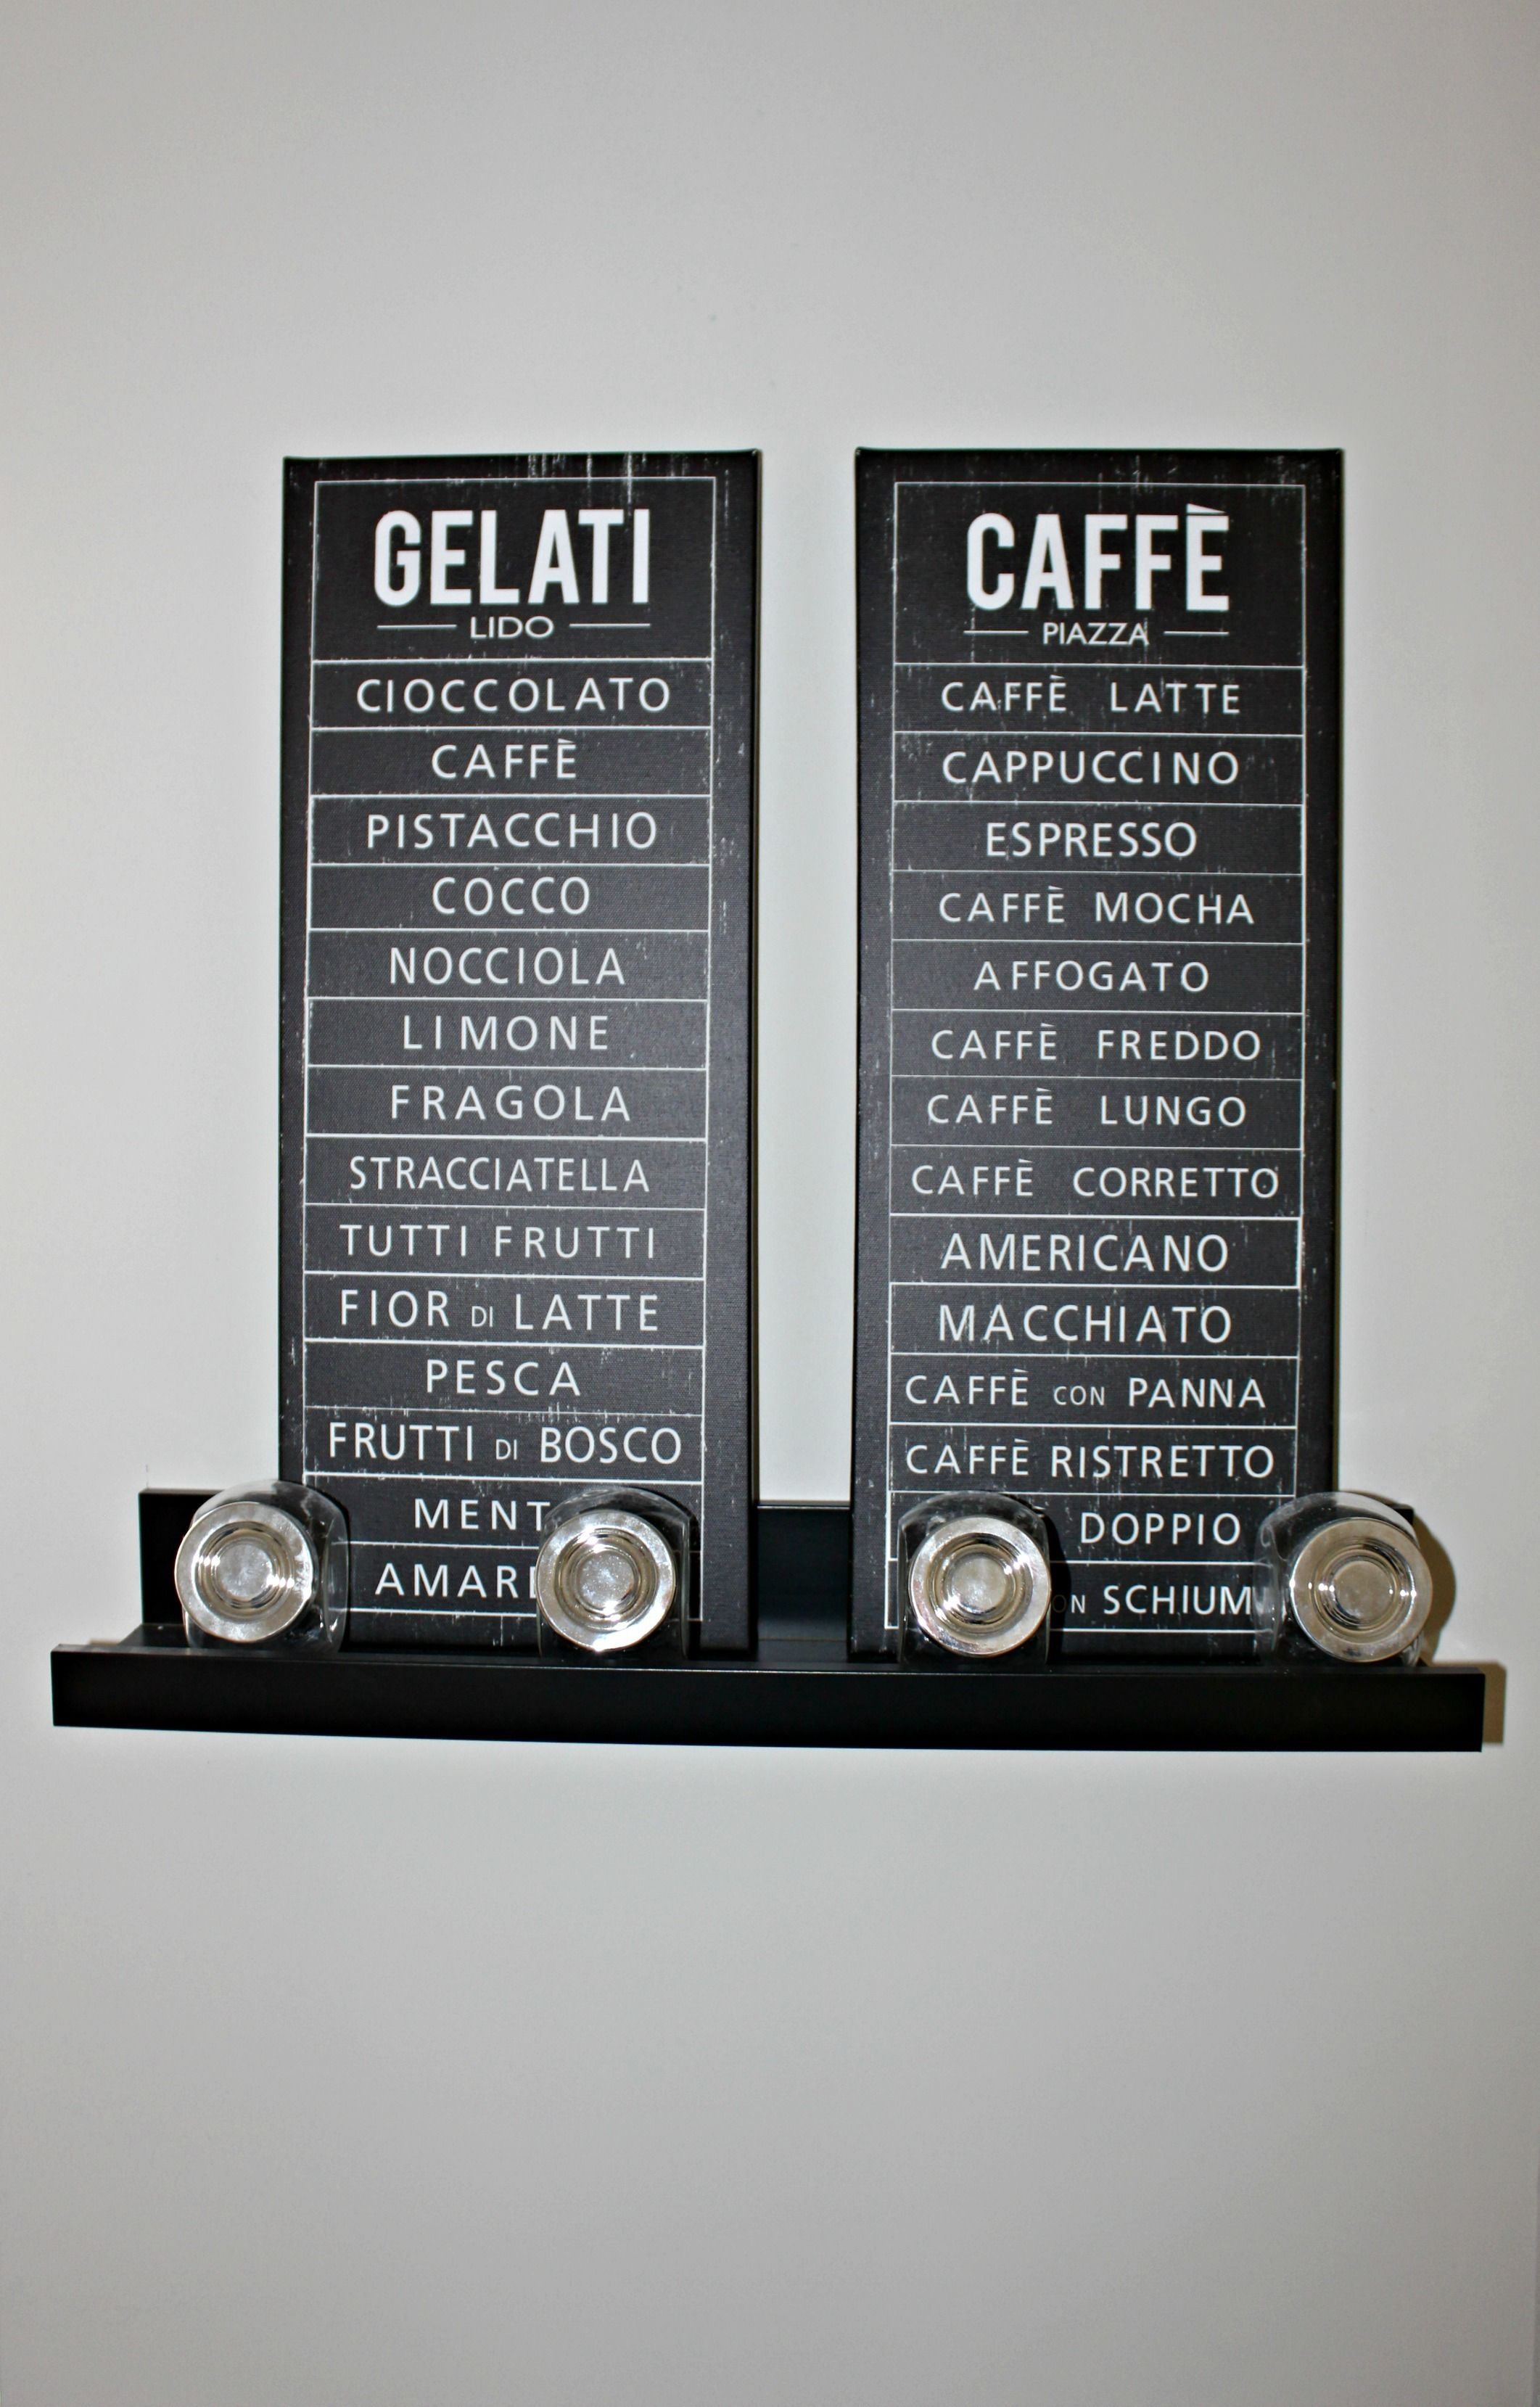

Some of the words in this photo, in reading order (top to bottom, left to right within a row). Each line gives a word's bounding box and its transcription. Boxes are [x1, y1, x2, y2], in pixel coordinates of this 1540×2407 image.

[374, 509, 649, 606] GELATI
[967, 503, 1229, 612] CAFFÈ
[471, 616, 554, 638] LIDO
[1043, 622, 1149, 646] PIAZZA
[357, 678, 670, 712] CIOCCOLATO
[942, 675, 1066, 712] CAFFÈ
[1111, 682, 1240, 714] LATTE
[432, 738, 577, 779] CAFFÈ
[942, 750, 1238, 784] CAPPUCCINO
[368, 811, 657, 849] PISTACCHIO
[987, 821, 1196, 857] ESPRESSO
[432, 876, 590, 916] COCCO
[939, 885, 1065, 923] CAFFÈ
[1095, 892, 1254, 924] MOCHA
[390, 947, 625, 985] NOCCIOLA
[973, 960, 1208, 992] AFFOGATO
[403, 1015, 609, 1052] LIMONE
[931, 1022, 1057, 1061] CAFFÈ
[1098, 1029, 1260, 1061] FREDDO
[392, 1084, 630, 1122] FRAGOLA
[927, 1087, 1053, 1124] CAFFÈ
[1101, 1095, 1245, 1127] LUNGO
[350, 1156, 650, 1193] STRACCIATELLA
[911, 1159, 1033, 1196] CAFFÈ
[1073, 1167, 1278, 1198] CORRETTO
[339, 1224, 466, 1257] TUTTI
[495, 1225, 654, 1259] FRUTTI
[940, 1233, 1228, 1272] AMERICANO
[341, 1289, 450, 1328] FIOR
[472, 1305, 493, 1328] DI
[515, 1293, 658, 1332] LATTE
[939, 1304, 1231, 1344] MACCHIATO
[427, 1359, 581, 1396] PESCA
[905, 1368, 1029, 1406] CAFFÈ
[1053, 1386, 1105, 1406] CON
[1129, 1378, 1266, 1408] PANNA
[329, 1422, 472, 1462] FRUTTI
[495, 1439, 517, 1460] DI
[540, 1425, 682, 1465] BOSCO
[906, 1438, 1029, 1476] CAFFÈ
[1051, 1445, 1274, 1478] RISTRETTO
[413, 1497, 551, 1532] MENT
[1081, 1512, 1240, 1545] DOPPIO
[1051, 1593, 1086, 1615] ON
[1102, 1584, 1252, 1616] SCHIUM
